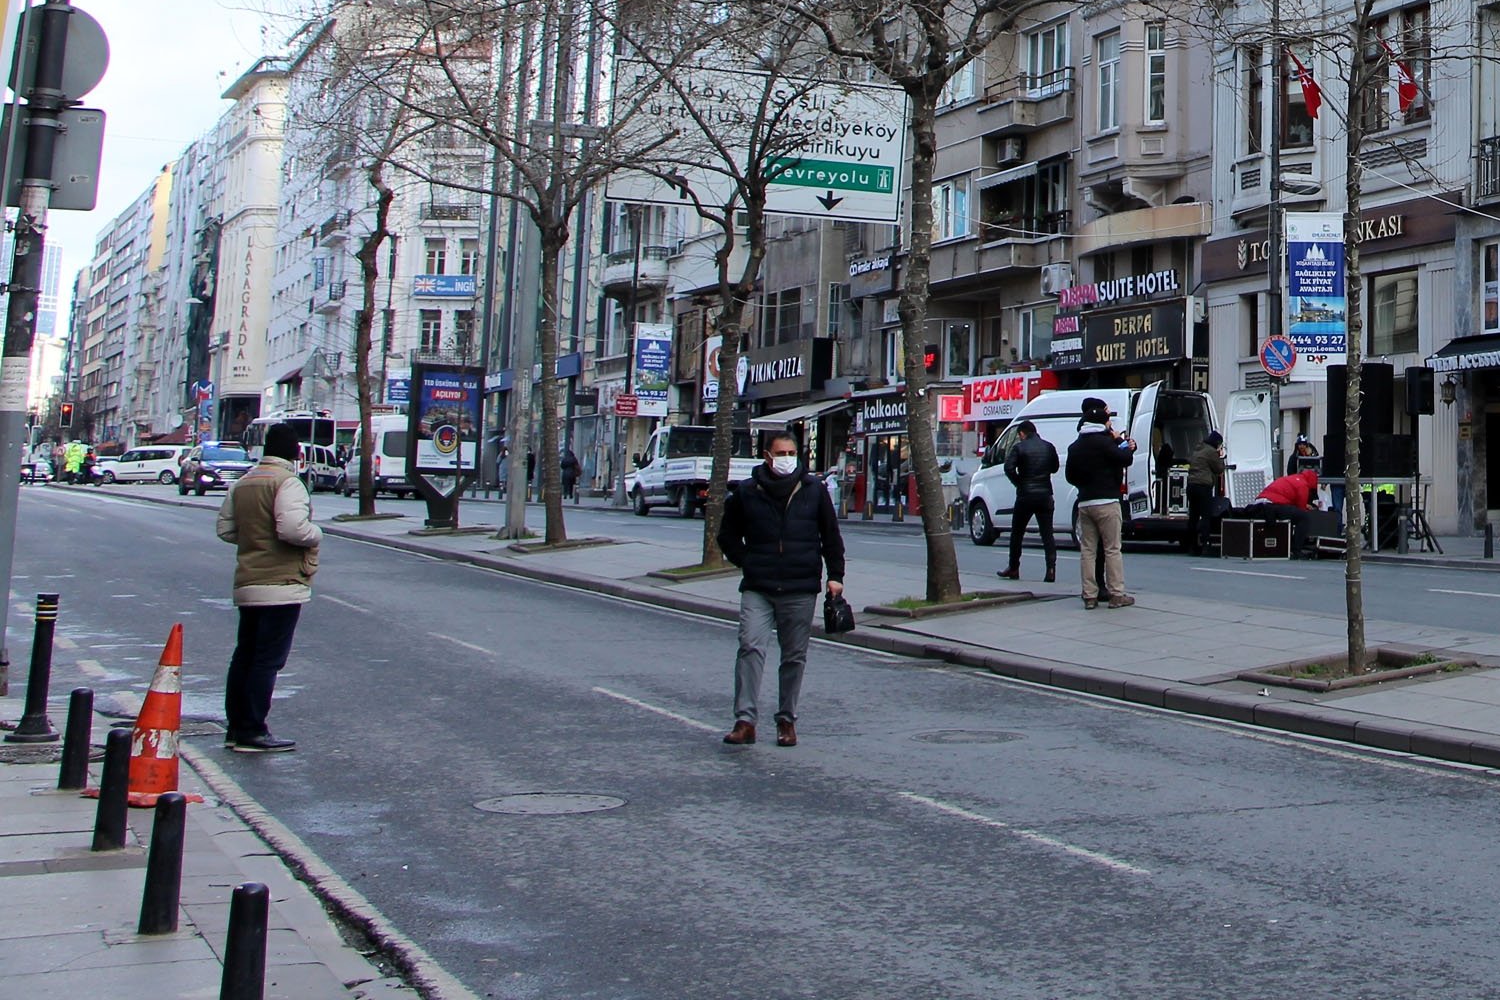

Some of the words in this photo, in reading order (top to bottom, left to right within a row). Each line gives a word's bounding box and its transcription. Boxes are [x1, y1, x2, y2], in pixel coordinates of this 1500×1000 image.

[774, 111, 897, 143] Mecidiyeköy
[1100, 276, 1134, 301] SUITE
[1136, 269, 1178, 296] HOTEL
[1114, 314, 1152, 336] DERPA
[1096, 342, 1126, 363] SUITE
[1136, 336, 1170, 360] HOTEL
[1290, 335, 1312, 344] 444
[1315, 335, 1328, 344] 93
[1331, 335, 1344, 344] 27
[1294, 345, 1344, 353] apyapi.com.tr
[750, 361, 777, 383] VIKING
[778, 355, 805, 379] PIZZA
[972, 376, 1025, 402] ECZANE
[983, 405, 1013, 416] OSMANBEY
